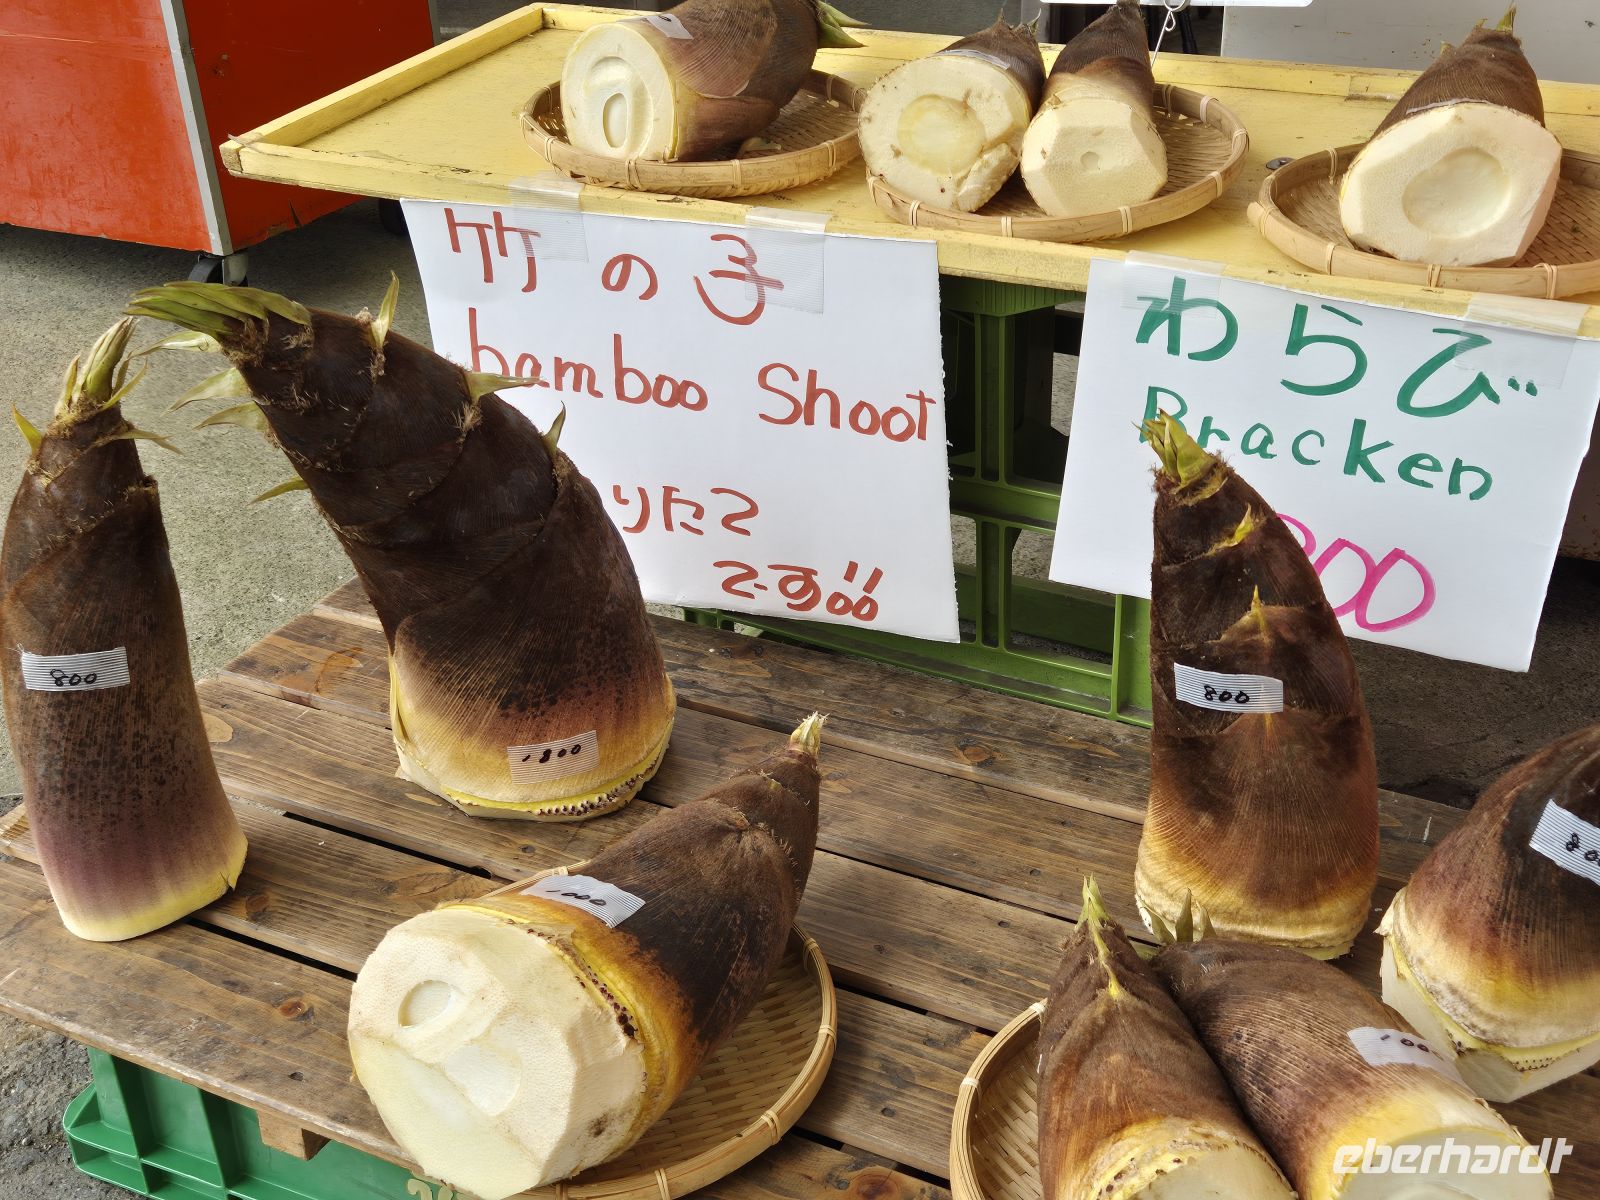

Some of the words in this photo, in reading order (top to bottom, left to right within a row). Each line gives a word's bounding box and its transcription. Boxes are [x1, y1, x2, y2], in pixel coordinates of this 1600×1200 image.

[444, 207, 785, 325] 竹の子
[468, 307, 709, 412] bamboo
[757, 362, 937, 442] Shoot
[1135, 276, 1538, 418] わらび
[1140, 386, 1493, 501] Bracken
[49, 668, 98, 687] 800
[1203, 684, 1250, 704] 800
[1565, 832, 1600, 867] 80
